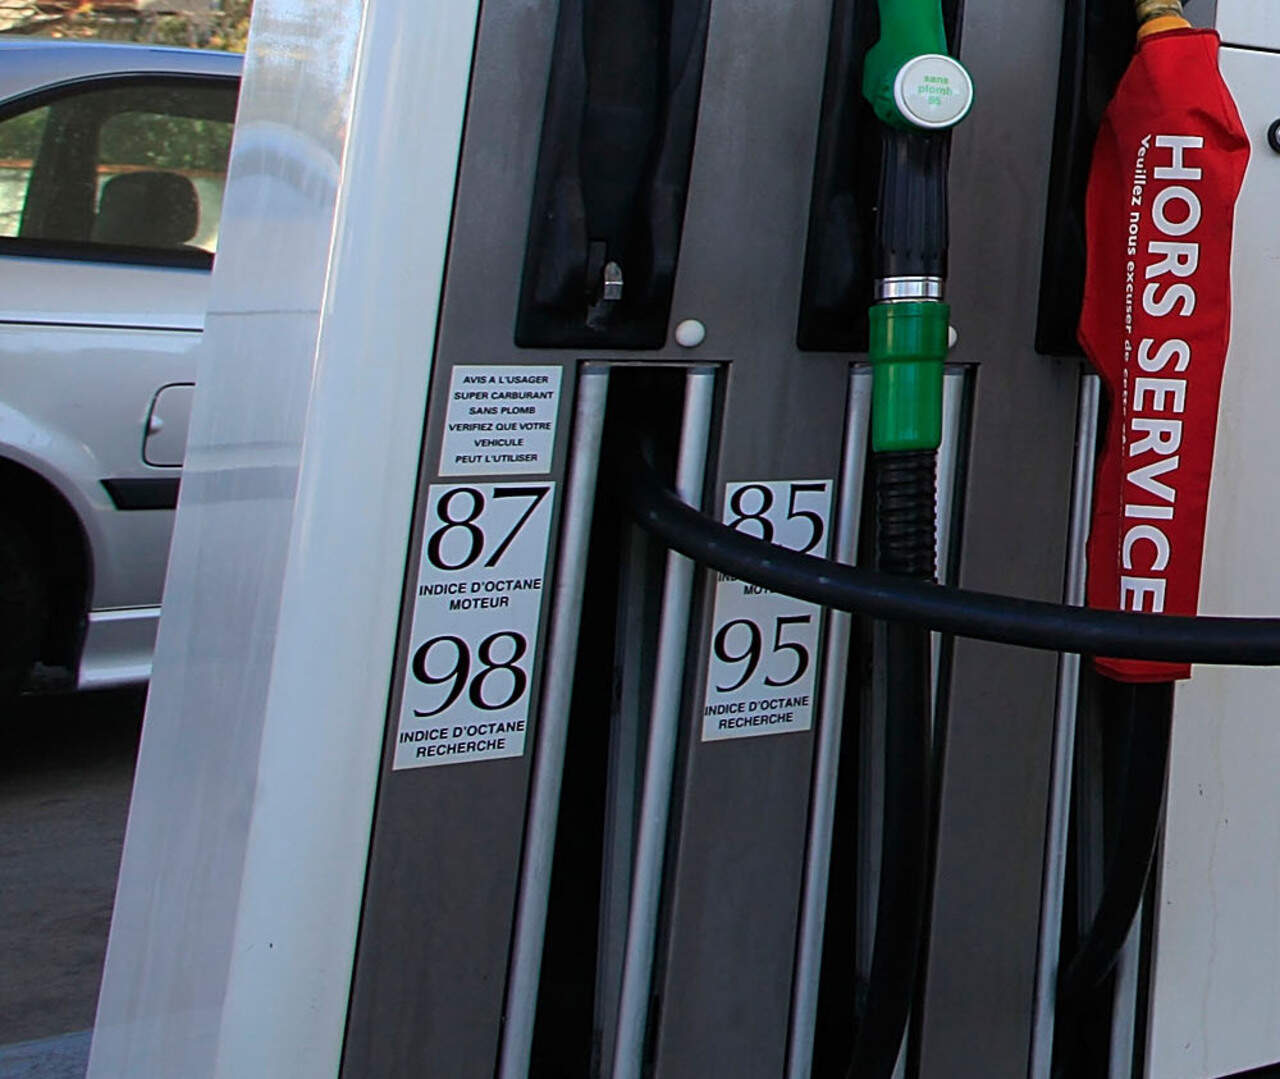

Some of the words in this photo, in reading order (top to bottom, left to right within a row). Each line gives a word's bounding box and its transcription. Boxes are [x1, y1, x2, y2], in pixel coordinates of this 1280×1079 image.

[924, 75, 949, 85] sans
[1131, 134, 1152, 206] Veuillez
[1127, 212, 1141, 256] nous
[1142, 134, 1205, 318] HORS
[1125, 260, 1135, 335] excuser
[463, 376, 487, 384] AVIS
[488, 376, 496, 384] A
[499, 376, 549, 384] L'USAGER
[454, 391, 488, 400] SUPER
[490, 391, 554, 400] CARBURANT
[469, 407, 498, 415] SANS
[500, 406, 536, 415] PLOMB
[448, 423, 494, 431] VERIFIEZ
[495, 422, 518, 431] QUE
[519, 422, 552, 431] VOTRE
[474, 438, 524, 447] VEHICULE
[455, 454, 482, 463] PEUT
[485, 454, 539, 463] L'UTILISER
[1119, 337, 1191, 612] SERVICE
[728, 483, 827, 552] 85
[426, 486, 552, 571] 87
[419, 581, 467, 597] INDICE
[470, 578, 542, 594] D'OCTANE
[449, 595, 510, 611] MOTEUR
[713, 614, 812, 694] 95
[411, 630, 528, 718] 98
[705, 703, 746, 718] INDICE
[748, 696, 810, 713] D'OCTANE
[717, 712, 794, 730] RECHERCHE
[400, 726, 450, 744] INDICE
[453, 720, 526, 739] D'OCTANE
[416, 738, 506, 758] RECHERCHE
